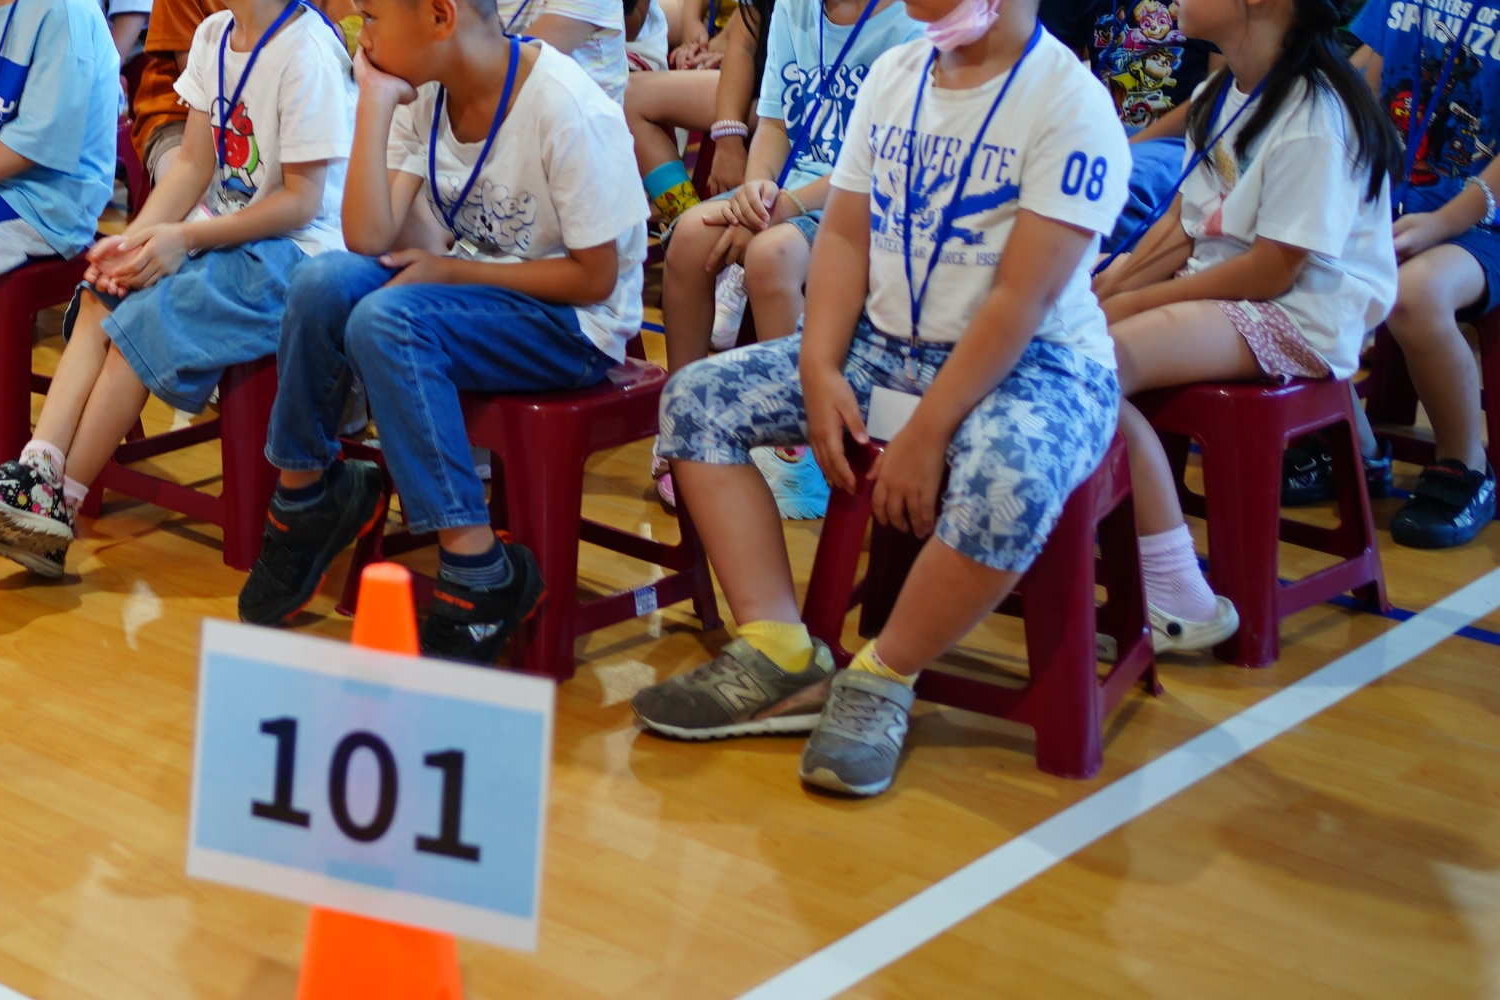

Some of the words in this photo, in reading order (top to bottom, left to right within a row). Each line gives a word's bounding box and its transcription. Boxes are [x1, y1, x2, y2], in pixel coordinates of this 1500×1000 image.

[1386, 1, 1500, 61] SPNJITZ
[1476, 6, 1500, 25] OF
[870, 123, 1017, 185] GENERTE
[1060, 150, 1108, 202] 08
[937, 249, 967, 266] INCE
[250, 714, 482, 863] 101
